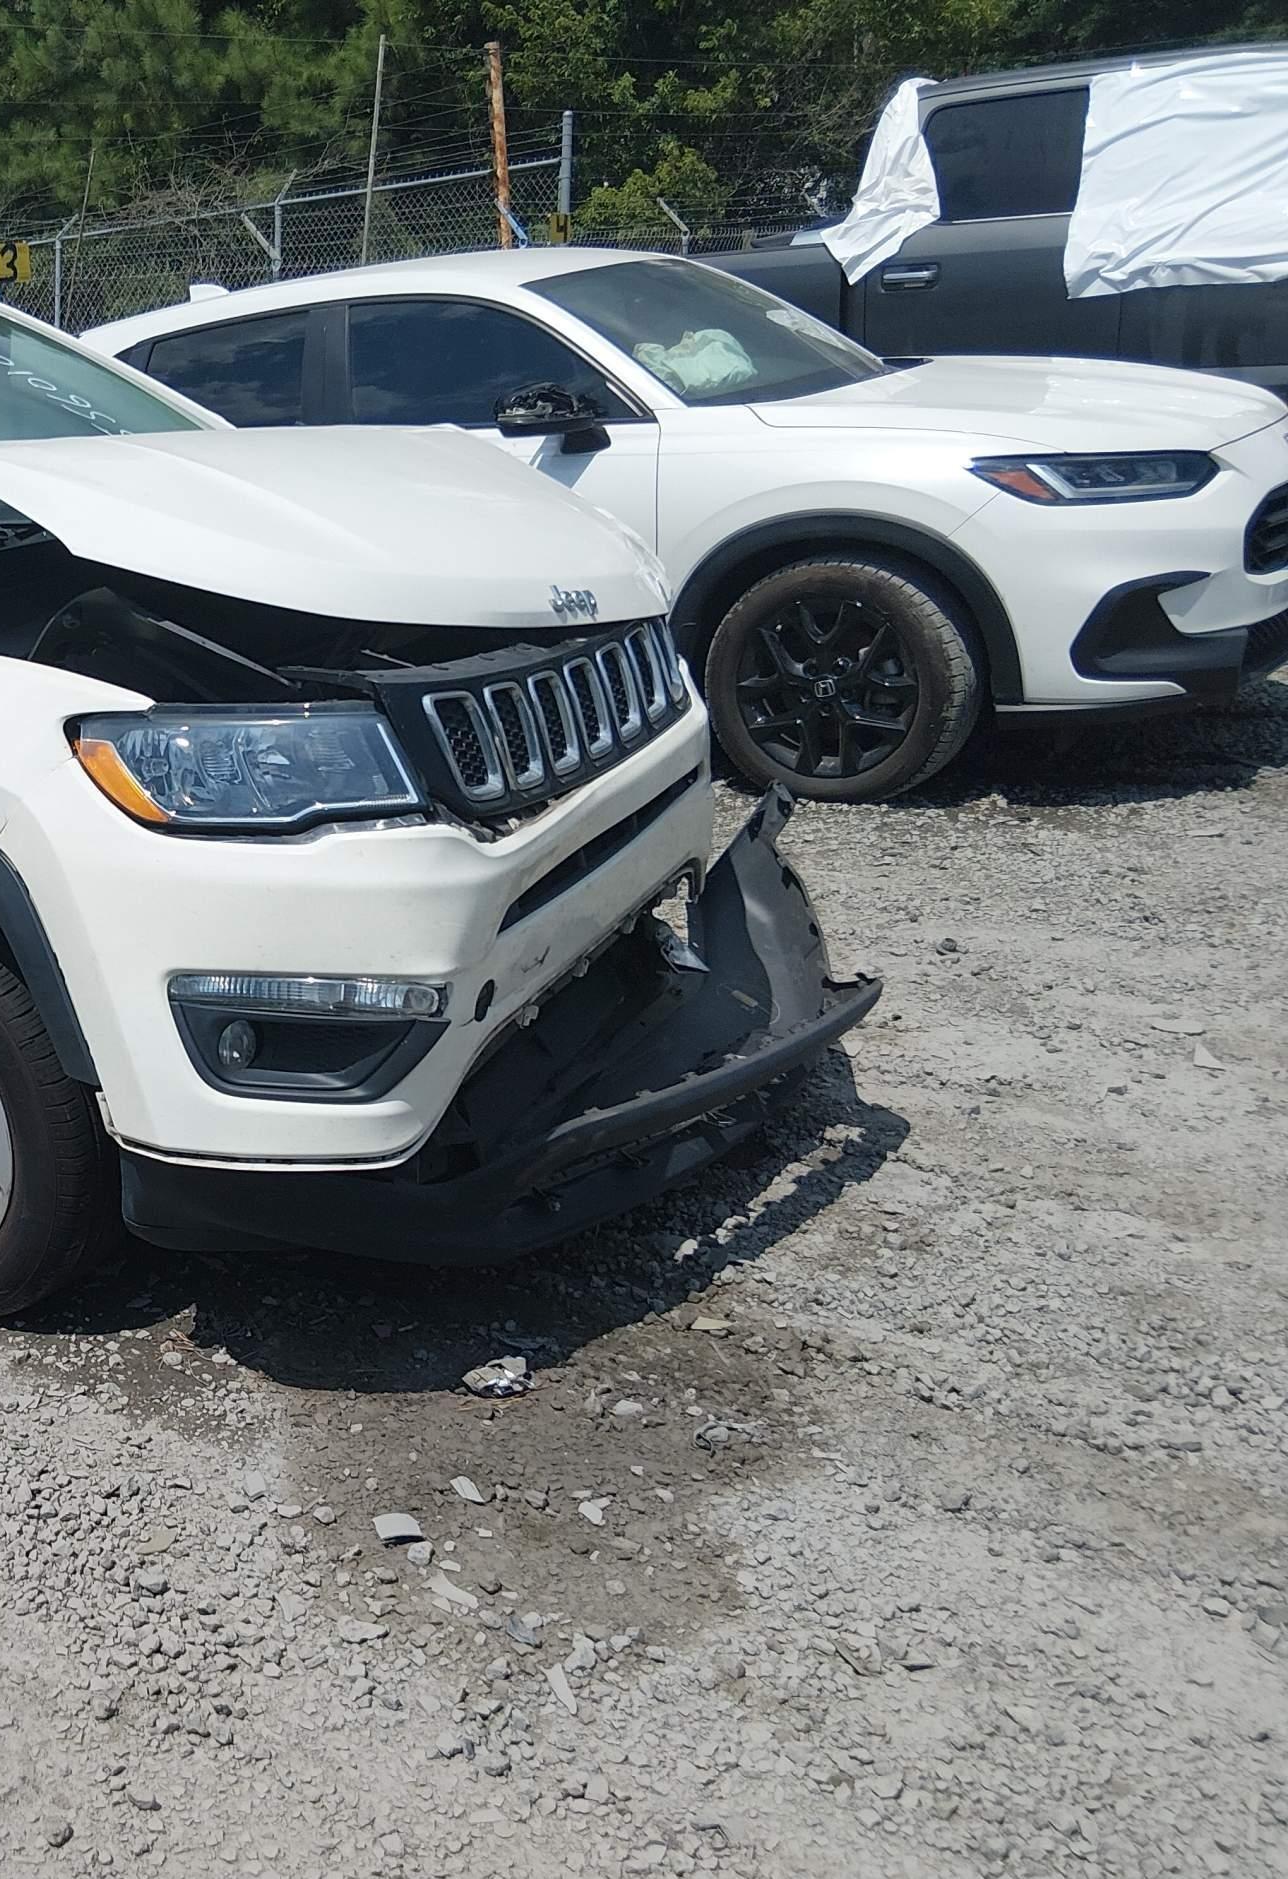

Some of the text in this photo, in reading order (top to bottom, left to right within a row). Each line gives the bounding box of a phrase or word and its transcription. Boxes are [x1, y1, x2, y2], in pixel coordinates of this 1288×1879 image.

[555, 213, 568, 243] 4
[0, 241, 18, 282] 3
[548, 584, 598, 617] Jeep
